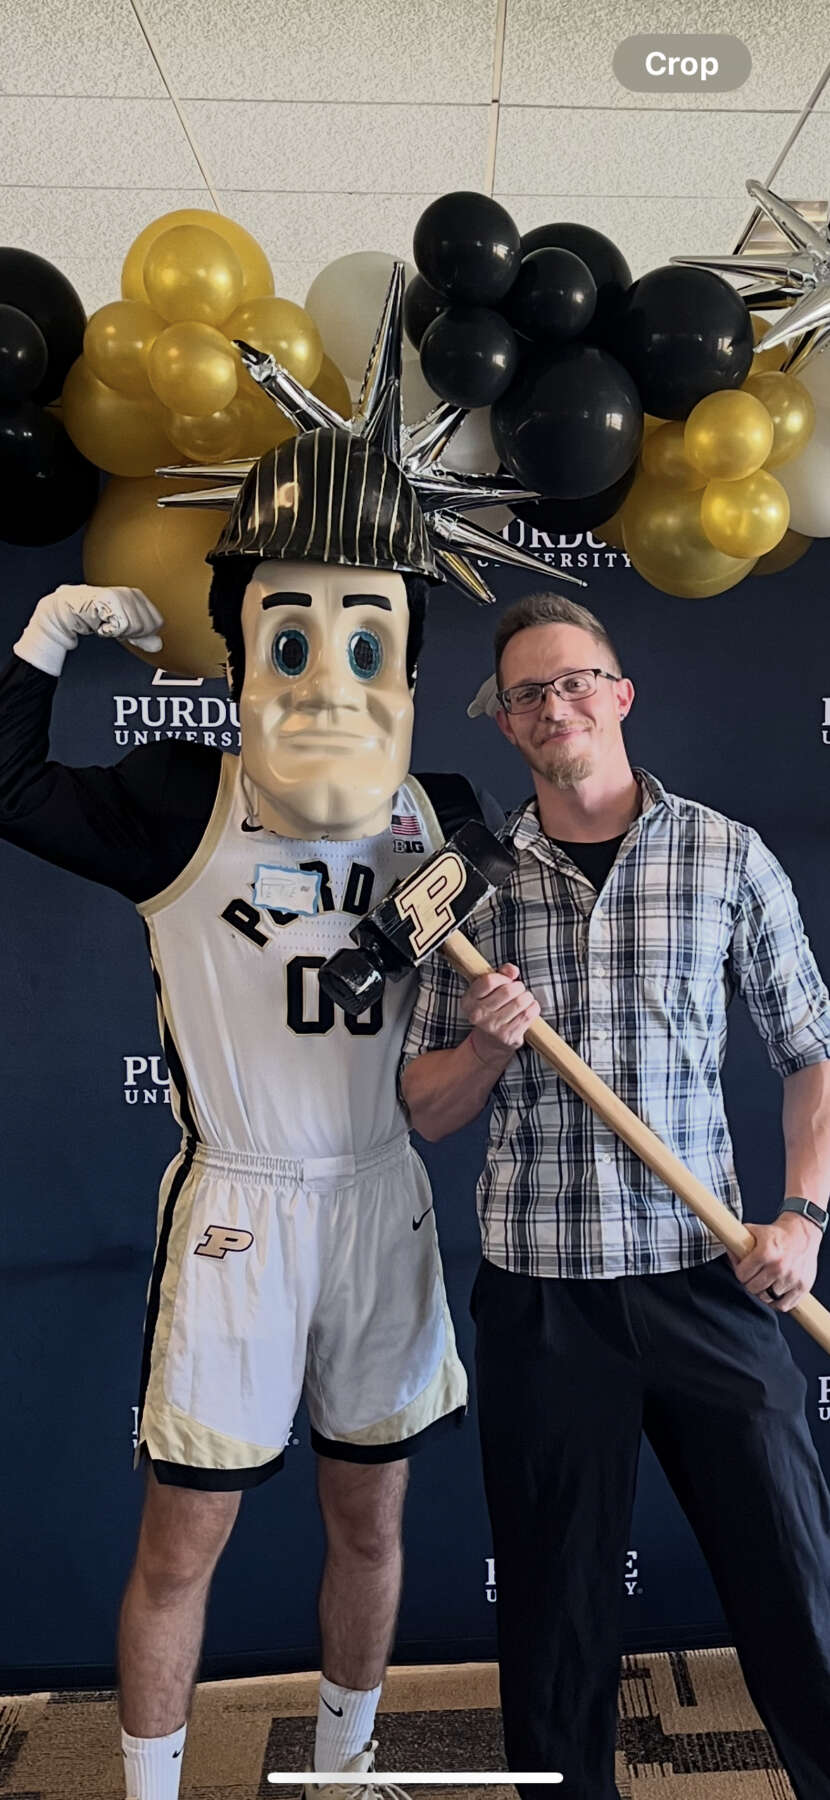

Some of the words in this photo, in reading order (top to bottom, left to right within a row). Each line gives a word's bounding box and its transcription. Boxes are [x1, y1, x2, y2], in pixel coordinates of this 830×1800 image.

[113, 696, 241, 727] PURD
[394, 851, 467, 957] P
[194, 1225, 254, 1259] P
